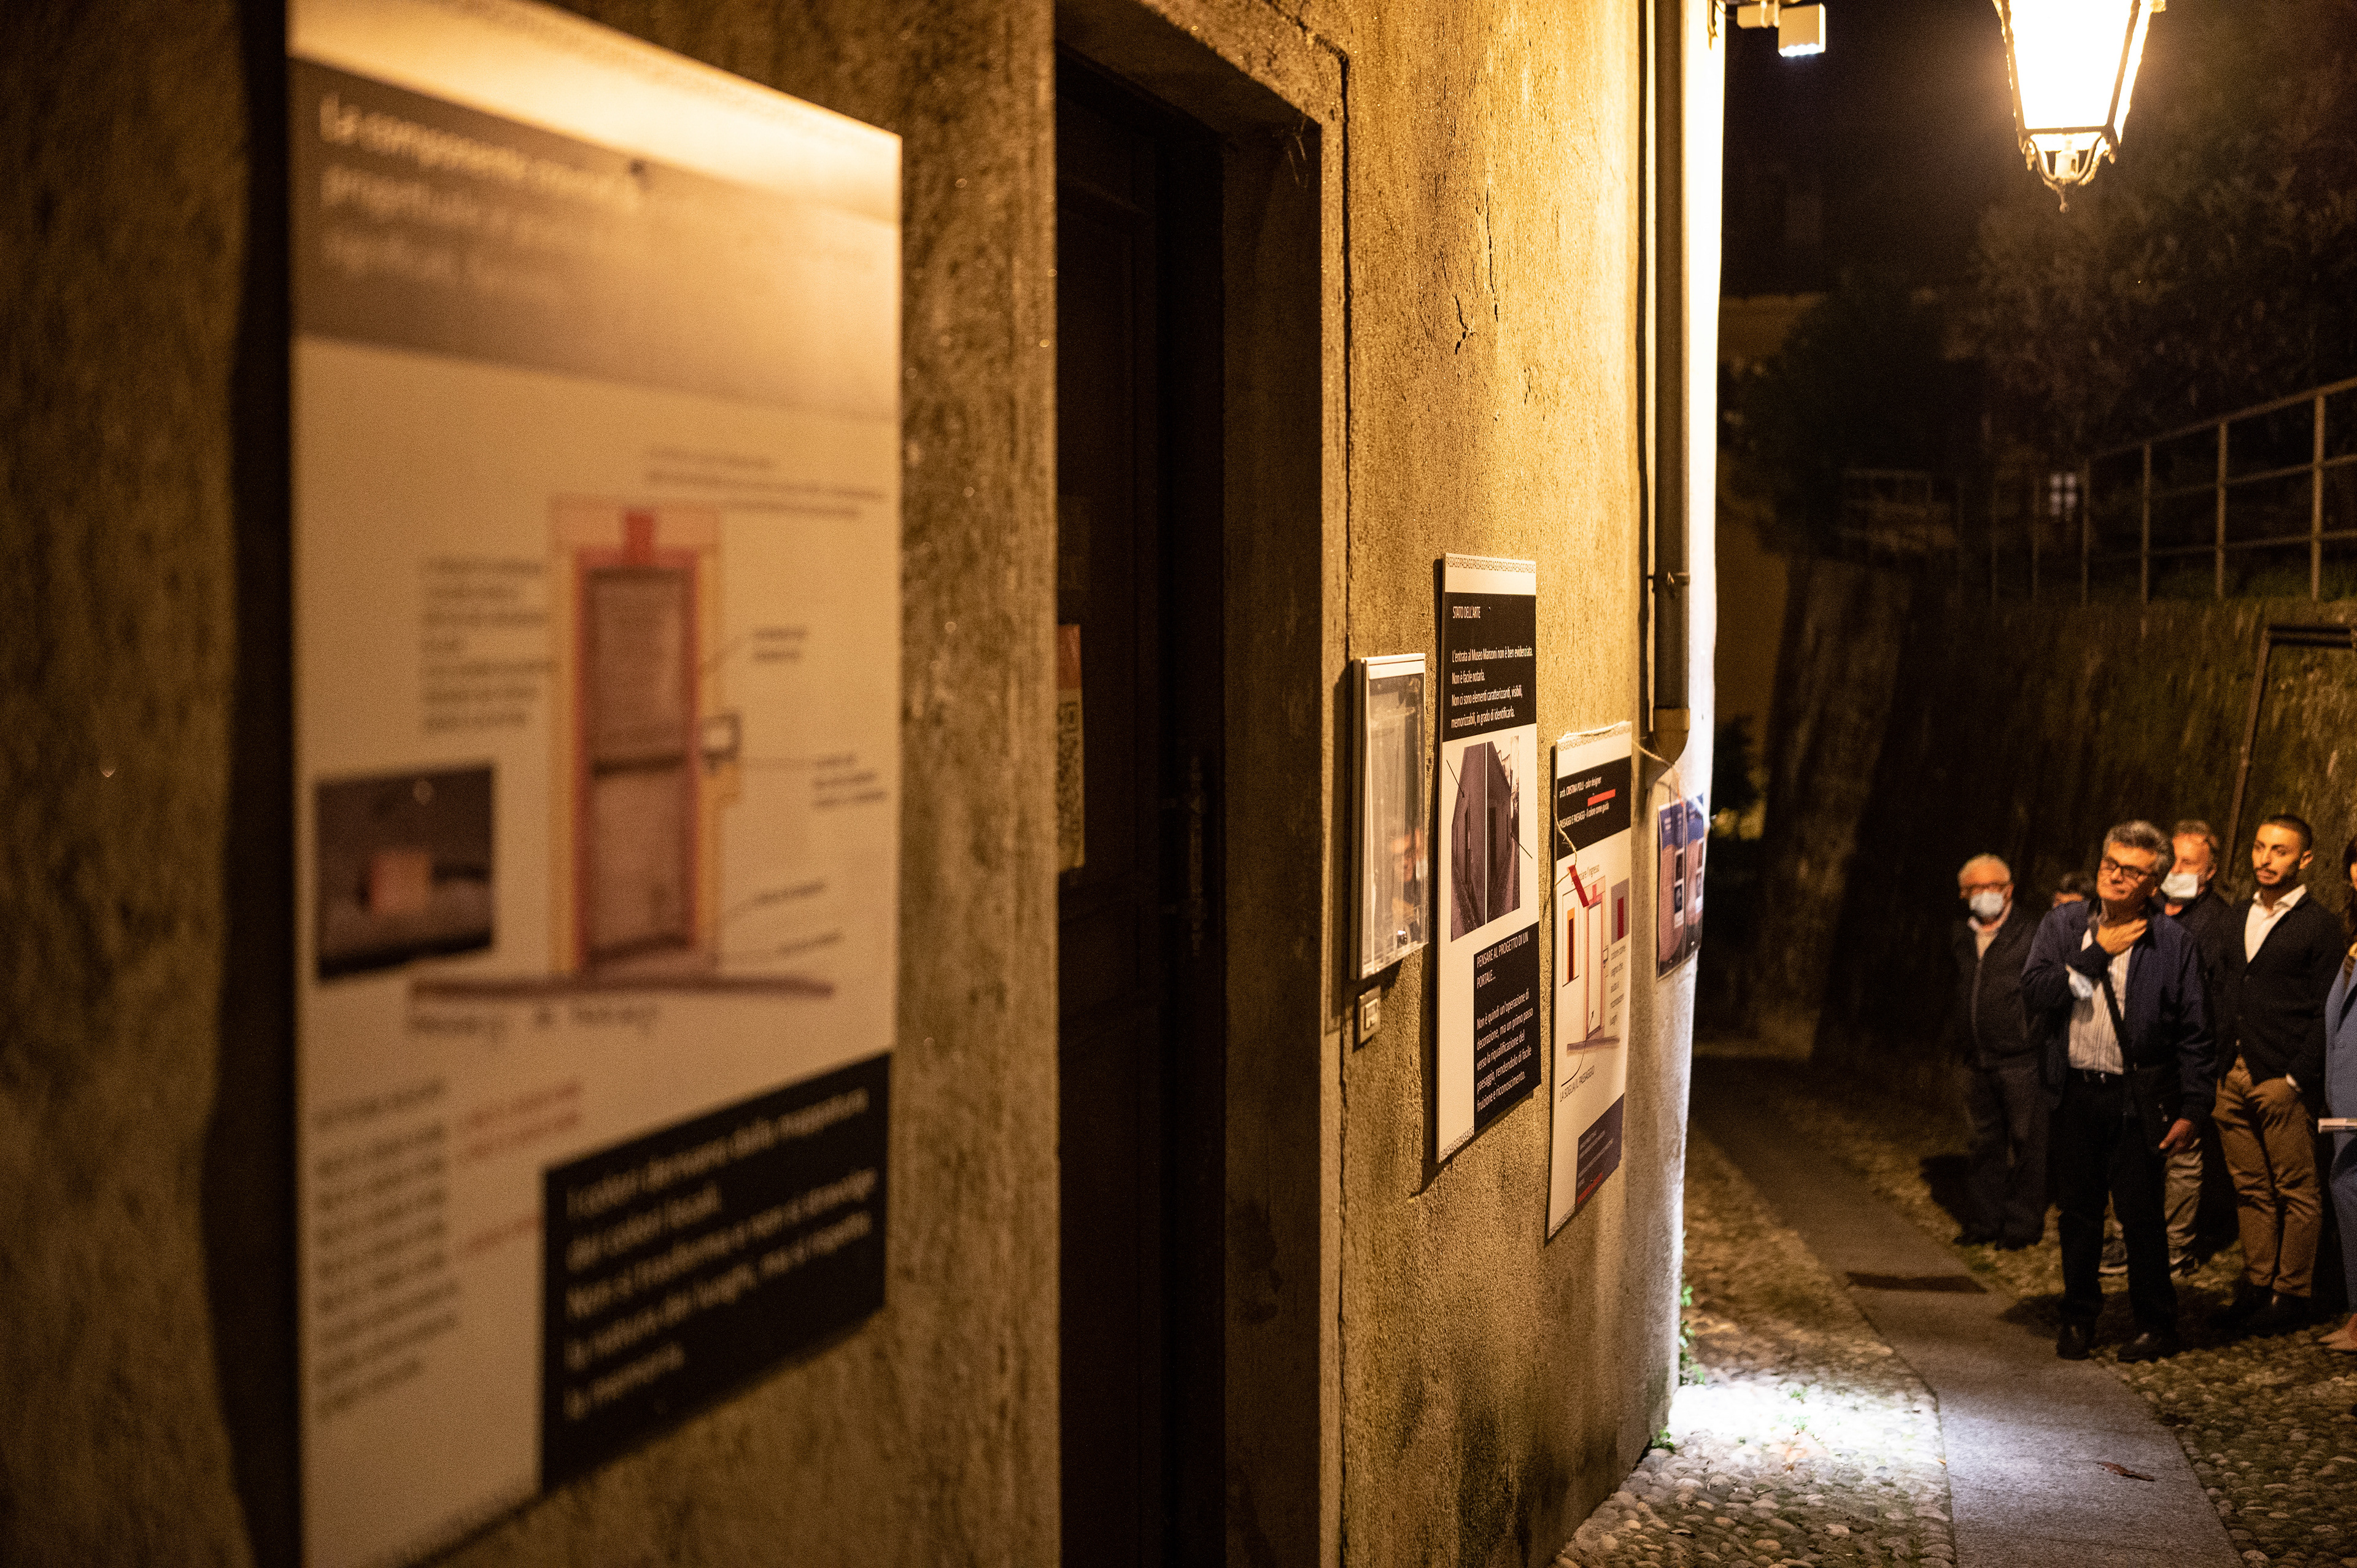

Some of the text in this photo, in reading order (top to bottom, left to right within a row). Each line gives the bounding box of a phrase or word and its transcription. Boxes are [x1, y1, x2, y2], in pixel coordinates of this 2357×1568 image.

[1453, 605, 1480, 619] STATO DELL'ARTE
[1452, 649, 1468, 663] L'entrata
[1468, 648, 1471, 662] al
[1472, 649, 1482, 661] Museo
[1483, 647, 1497, 660] Manzoni
[1514, 645, 1533, 657] evidenziata.
[1460, 671, 1463, 684] è
[1463, 670, 1473, 683] facile
[1473, 668, 1485, 682] notarla.
[1460, 693, 1463, 705] ci
[1463, 695, 1473, 705] sono
[1473, 689, 1487, 703] elementi
[1487, 686, 1511, 701] caratterizzanti,
[1511, 684, 1523, 698] visibili,
[1451, 706, 1515, 728] memorizzabili, in grado di identificarla.
[1566, 784, 1577, 796] CRISTINA
[1559, 815, 1571, 829] PASSAGGI
[1574, 810, 1585, 823] PAESAGGI
[1477, 931, 1528, 968] PENSARE AL PROGETTO DI UN
[1485, 1012, 1488, 1025] è
[1488, 1005, 1500, 1025] quindi
[1500, 994, 1525, 1016] un'operazione
[1525, 988, 1529, 1000] di
[1477, 1008, 1533, 1051] decorazione, ma un primo passo
[1477, 1057, 1487, 1071] verso
[1487, 1052, 1491, 1064] la
[1491, 1037, 1519, 1062] riqualificazione
[1477, 1045, 1532, 1095] paesaggio, rendendolo di facile
[1477, 1071, 1526, 1112] fruizione e riconoscimento.
